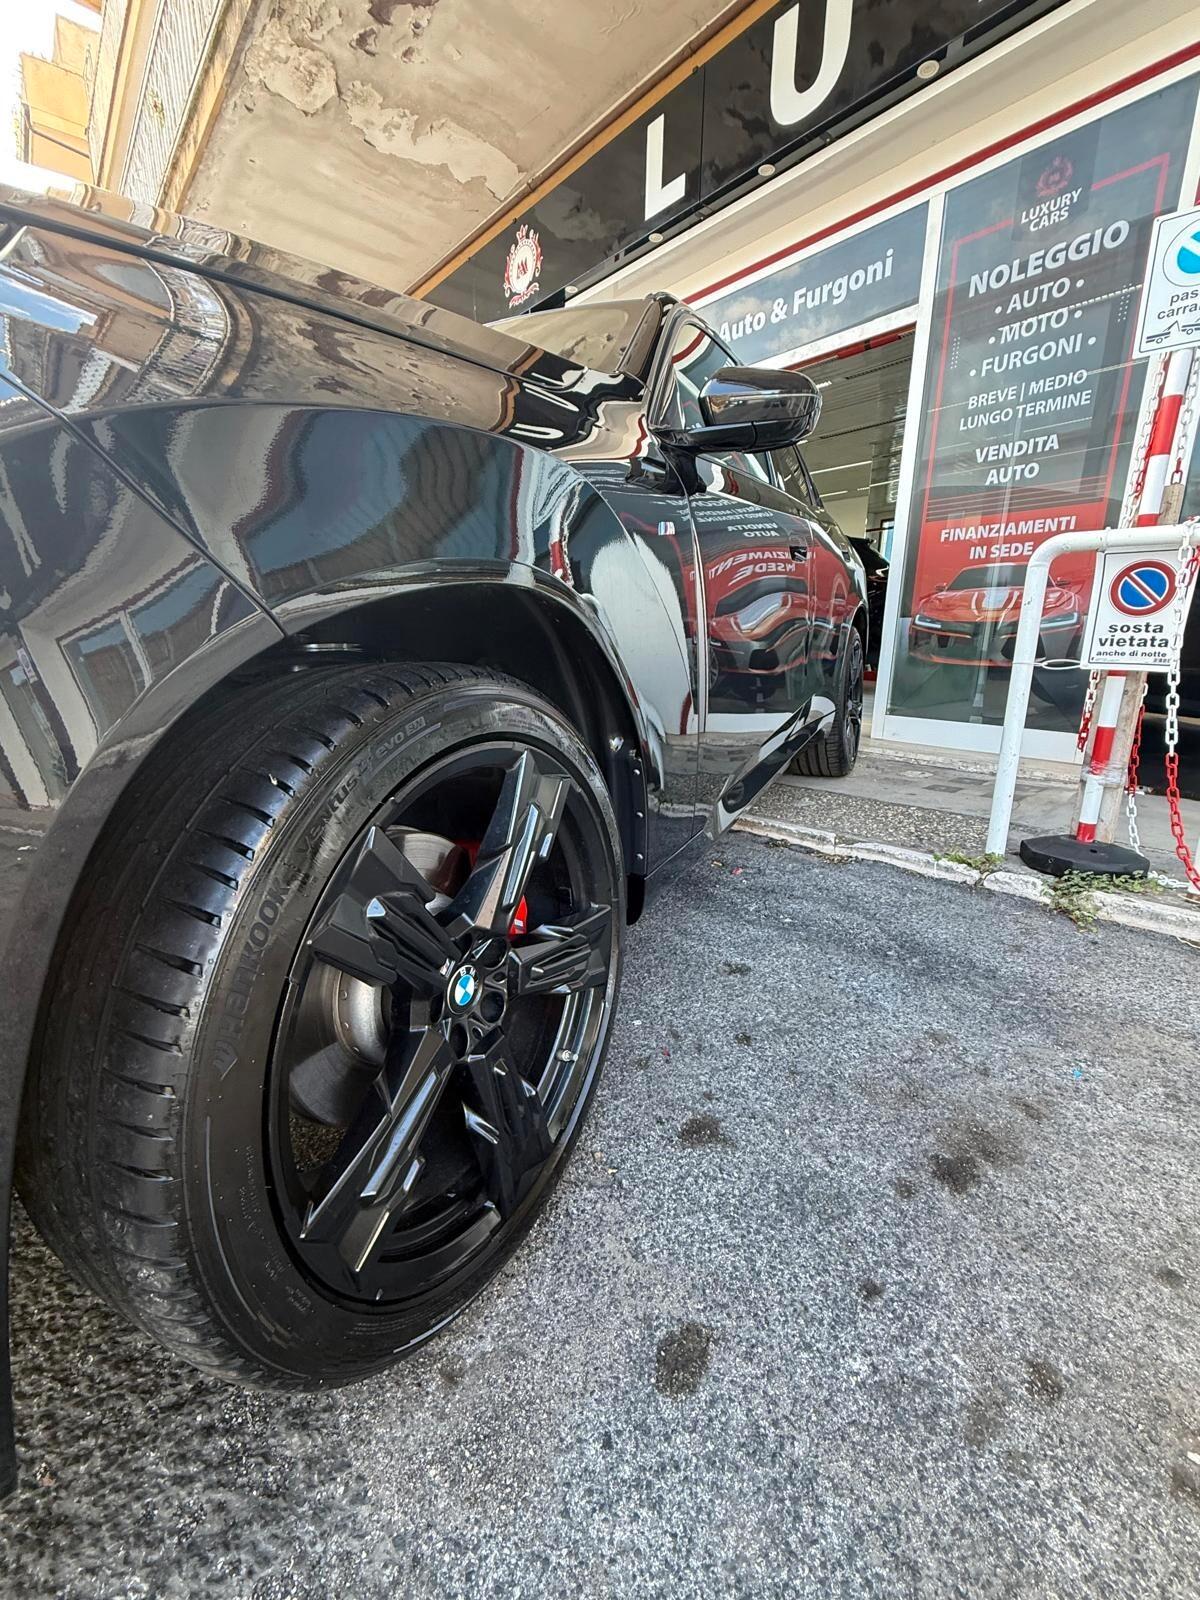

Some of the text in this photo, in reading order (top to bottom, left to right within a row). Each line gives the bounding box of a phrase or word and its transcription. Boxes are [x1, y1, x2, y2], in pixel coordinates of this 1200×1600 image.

[1020, 187, 1083, 225] LUXURY
[1029, 206, 1070, 232] CARS
[968, 219, 1130, 298] NOLEGGIO
[719, 248, 895, 343] Auto & Furgoni
[1006, 277, 1071, 314] AUTO
[1169, 289, 1200, 307] pas
[1157, 302, 1200, 320] carra
[999, 307, 1069, 345] MOTO
[981, 333, 1083, 377] FURGONI
[968, 385, 1018, 410] BREVE
[1028, 369, 1088, 396] MEDIO
[959, 389, 1092, 431] LUNGO TERMINE
[975, 433, 1060, 464] VENDITA
[984, 462, 1040, 486] AUTO
[940, 515, 1077, 543] FINANZIAMENTI
[969, 541, 1035, 560] IN SEDE
[1098, 634, 1169, 648] vietata
[1108, 621, 1165, 634] sosta
[1128, 649, 1139, 657] di
[1140, 650, 1167, 658] notte
